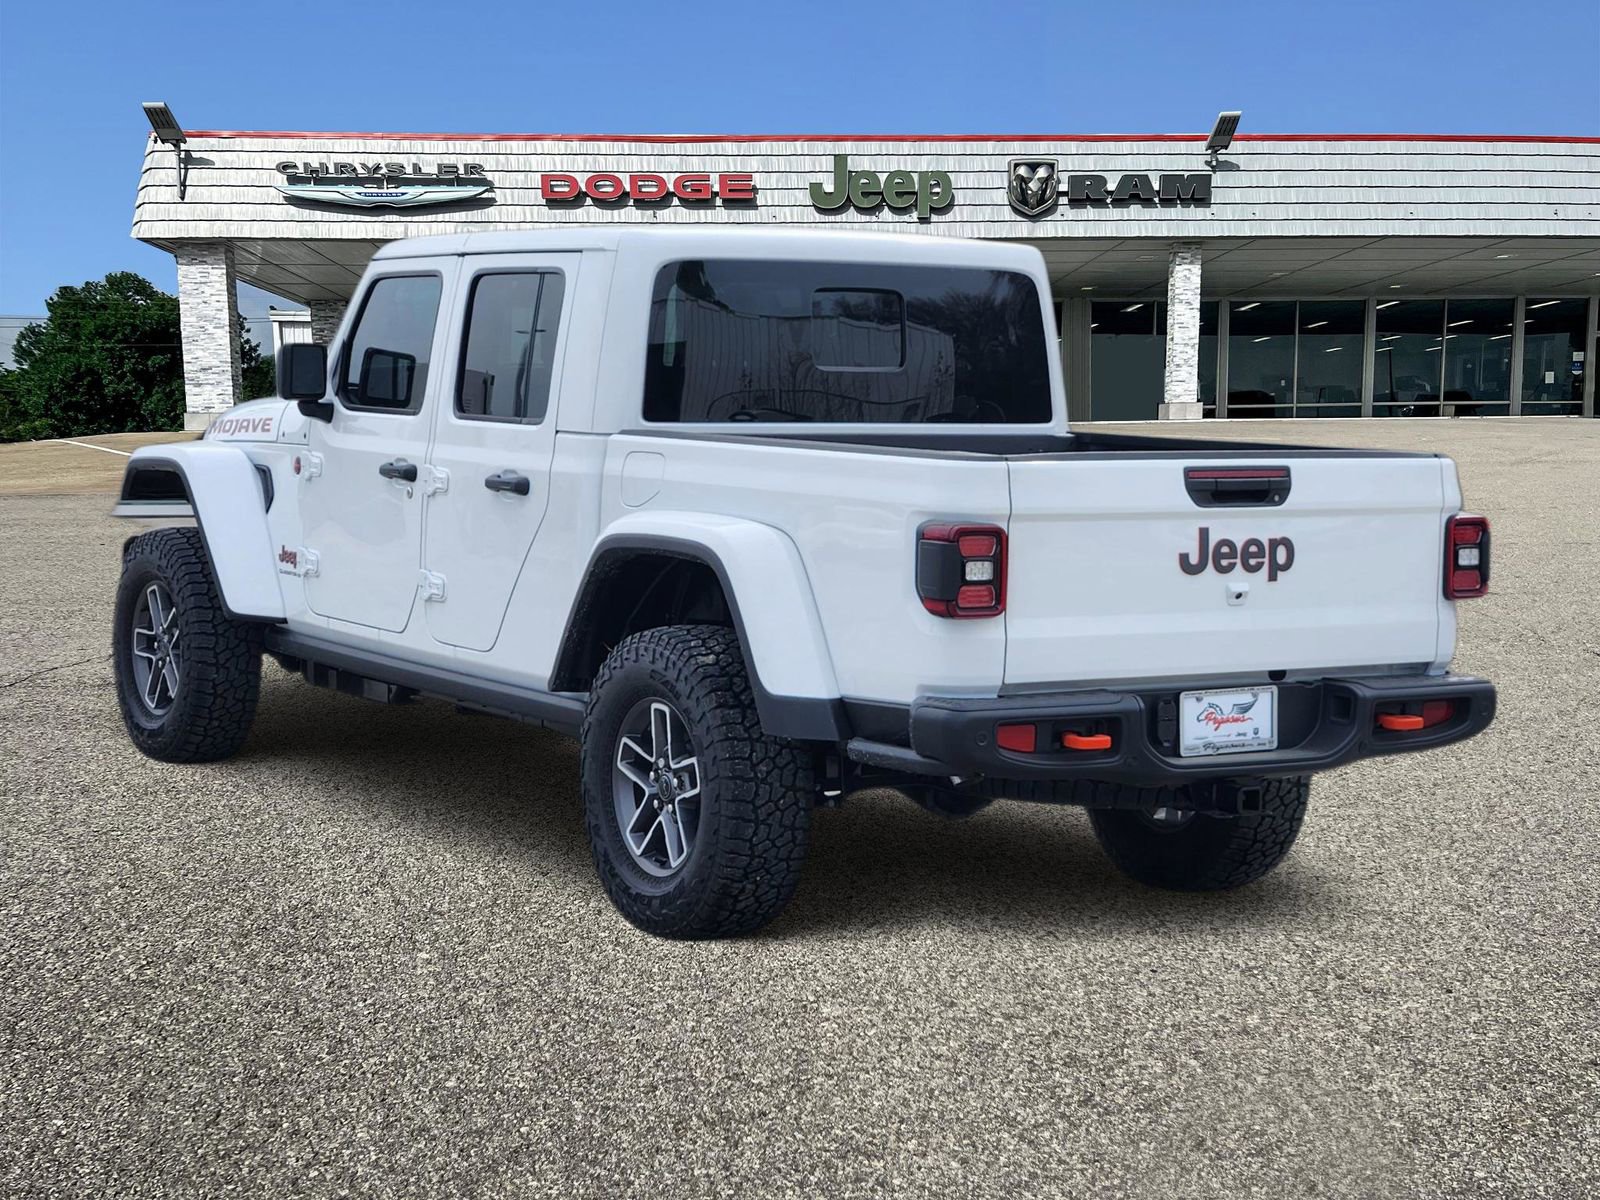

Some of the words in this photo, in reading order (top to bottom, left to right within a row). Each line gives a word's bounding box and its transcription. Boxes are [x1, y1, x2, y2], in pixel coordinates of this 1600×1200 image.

[274, 161, 487, 178] CHRYSLER
[541, 173, 755, 202] DODGE
[808, 154, 953, 218] Jeep
[1067, 173, 1213, 202] RAM
[208, 417, 273, 436] MOJAVE
[278, 544, 298, 569] Jeep
[1178, 526, 1295, 582] Jeep
